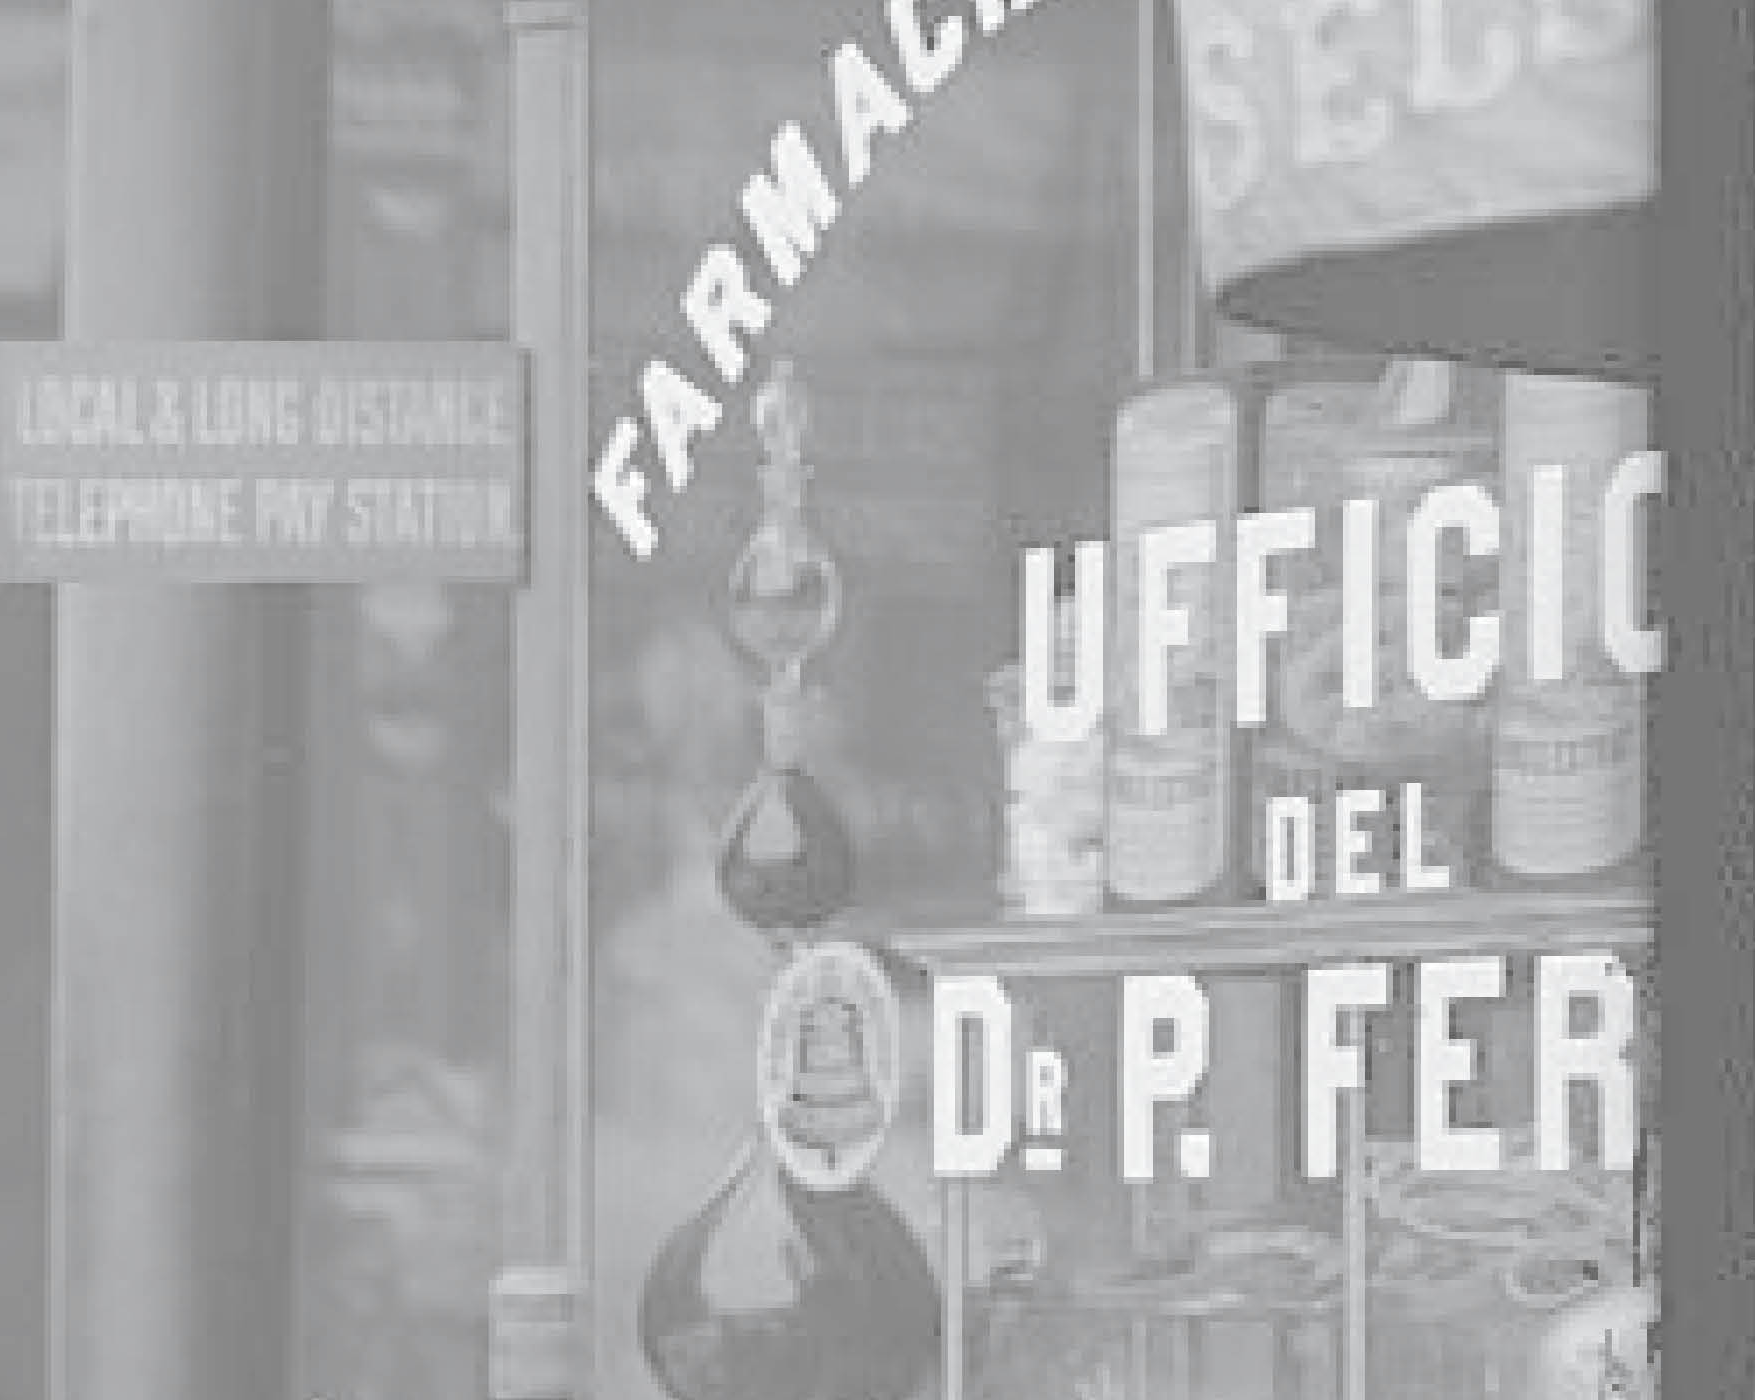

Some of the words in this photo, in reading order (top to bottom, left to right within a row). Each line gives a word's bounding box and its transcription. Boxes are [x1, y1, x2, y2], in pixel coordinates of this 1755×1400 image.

[593, 0, 1034, 560] FARMAC
[16, 375, 144, 447] LOCAL
[149, 375, 184, 447] &
[191, 375, 302, 447] LONG
[314, 375, 514, 447] DISTANCE
[10, 476, 243, 545] TELEPHONE
[254, 476, 334, 545] PAY
[1265, 782, 1451, 901] DEL
[1121, 974, 1212, 1178] P.
